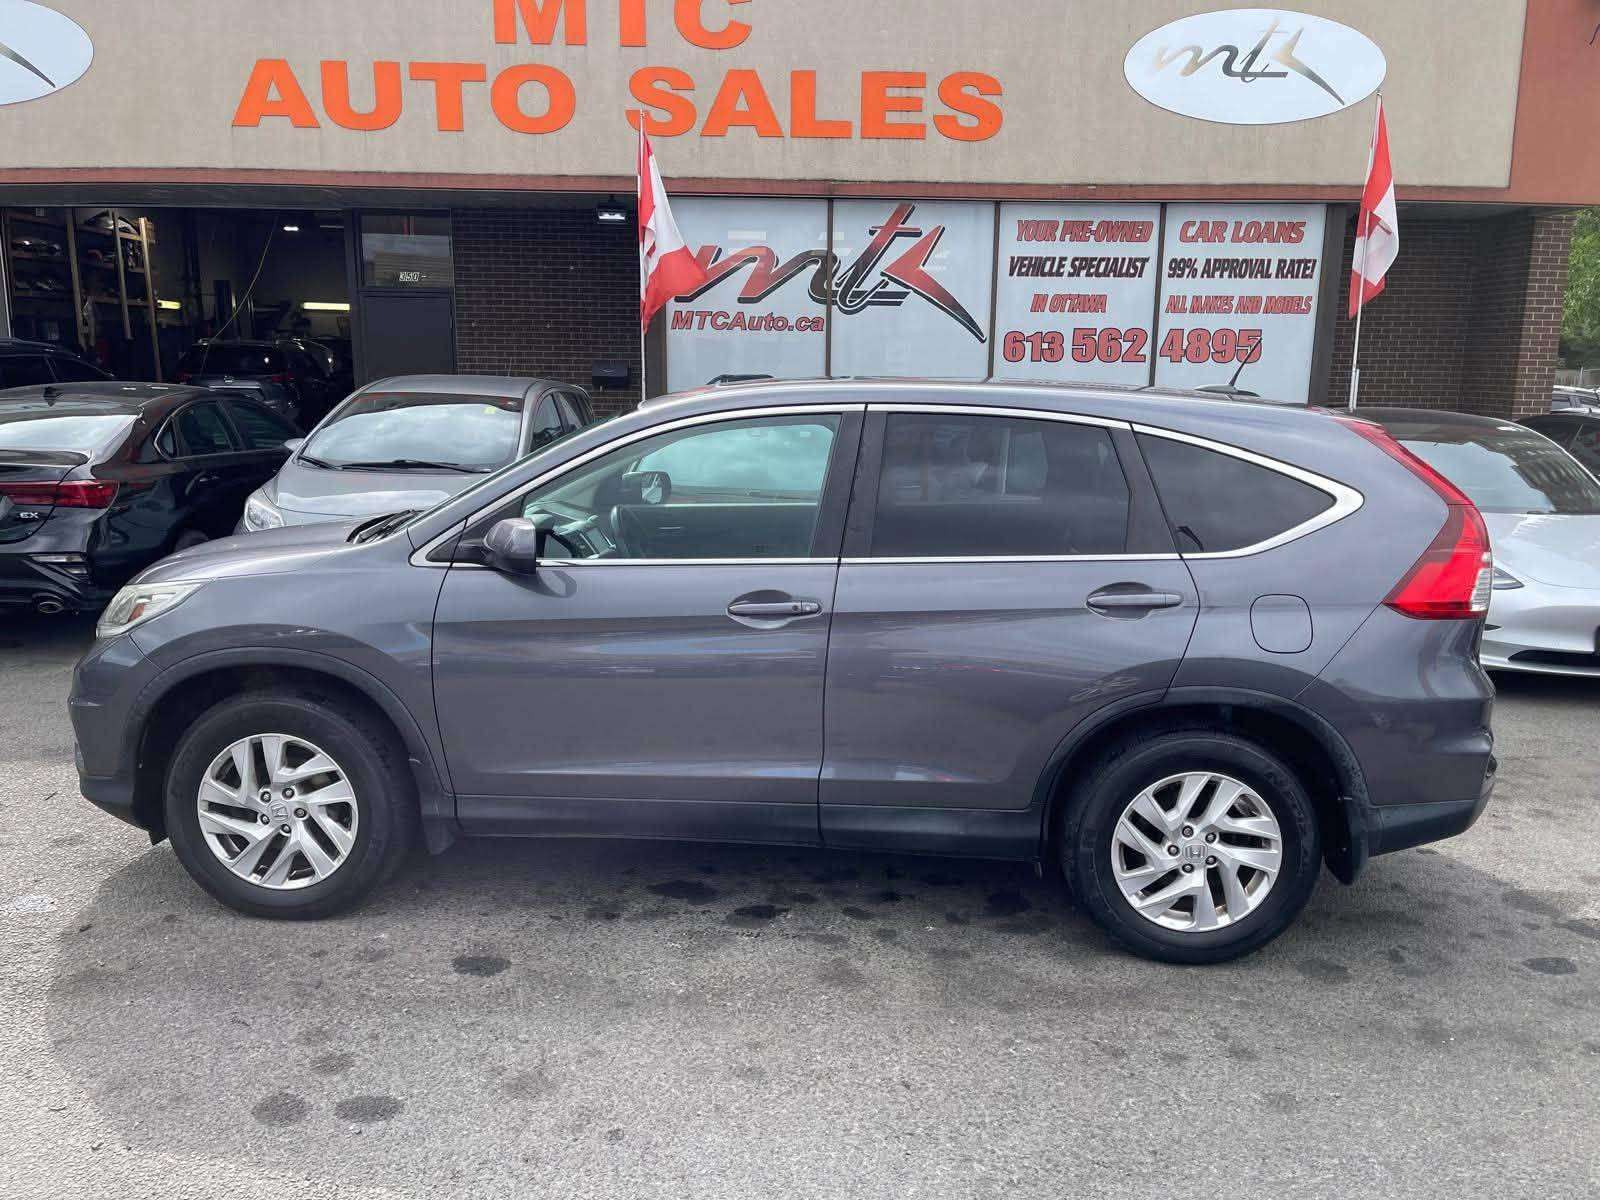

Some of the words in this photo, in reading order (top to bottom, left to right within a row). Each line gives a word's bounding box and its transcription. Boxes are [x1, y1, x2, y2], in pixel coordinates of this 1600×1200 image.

[232, 58, 577, 135] AUTO
[625, 66, 1003, 142] SALES
[1016, 219, 1059, 242] YOUR
[1059, 220, 1154, 243] PRE-OWNED
[1179, 220, 1228, 243] CAR
[1231, 220, 1307, 243] LOANS
[1008, 256, 1068, 278] VEHICLE
[1067, 256, 1150, 278] SPECIALIST
[1167, 257, 1198, 279] 99%
[1200, 258, 1272, 279] APPROVAL
[1275, 258, 1318, 280] RATE!
[1030, 293, 1049, 313] IN
[1048, 293, 1108, 313] OTTAWA
[1165, 294, 1188, 314] ALL
[1189, 295, 1235, 314] MAKES
[1234, 295, 1263, 314] AND
[1262, 295, 1313, 315] MODELS
[670, 310, 825, 332] MTCAuto.ca
[1003, 330, 1065, 363] 613
[1071, 327, 1149, 364] 562
[1159, 327, 1263, 364] 4895
